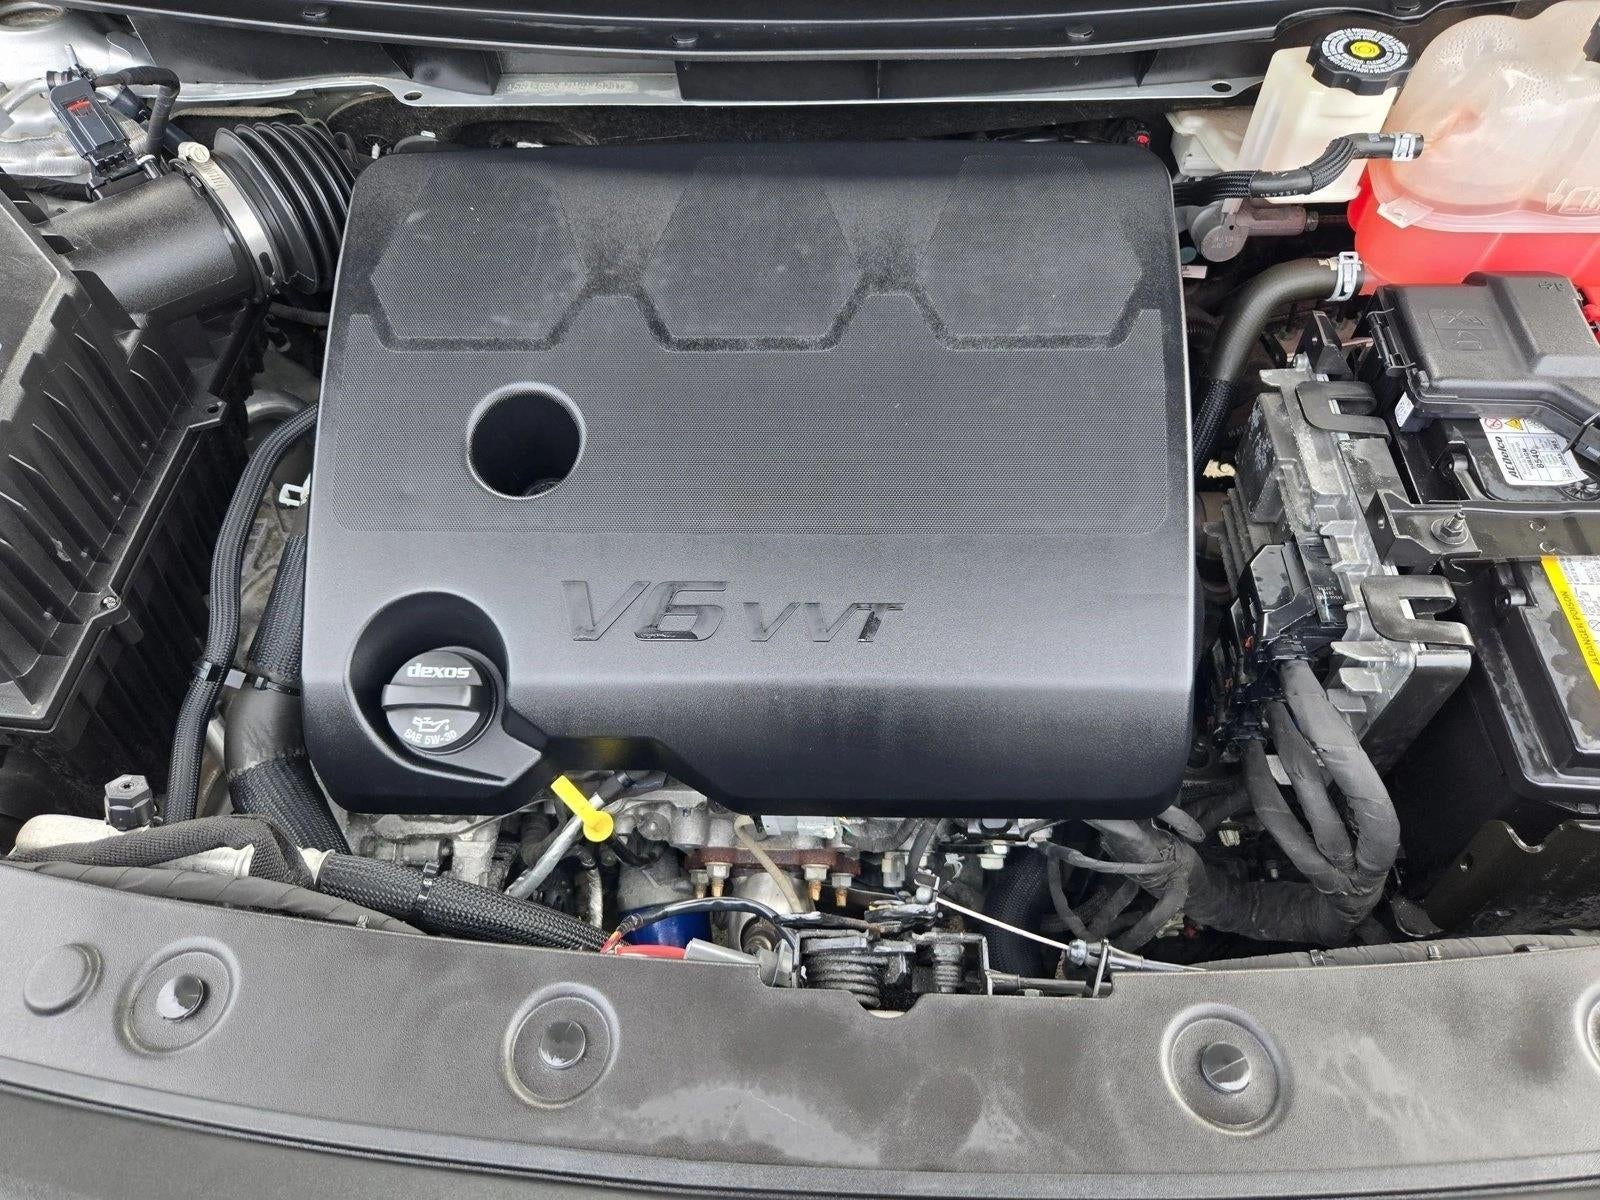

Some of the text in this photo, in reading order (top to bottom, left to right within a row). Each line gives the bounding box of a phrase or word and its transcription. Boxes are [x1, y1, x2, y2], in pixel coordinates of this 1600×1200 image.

[1495, 436, 1519, 478] ACDelco
[561, 580, 906, 642] V6 VVT
[1560, 590, 1581, 621] POISON
[406, 663, 473, 679] dexos
[403, 729, 457, 745] SAE 5W-30
